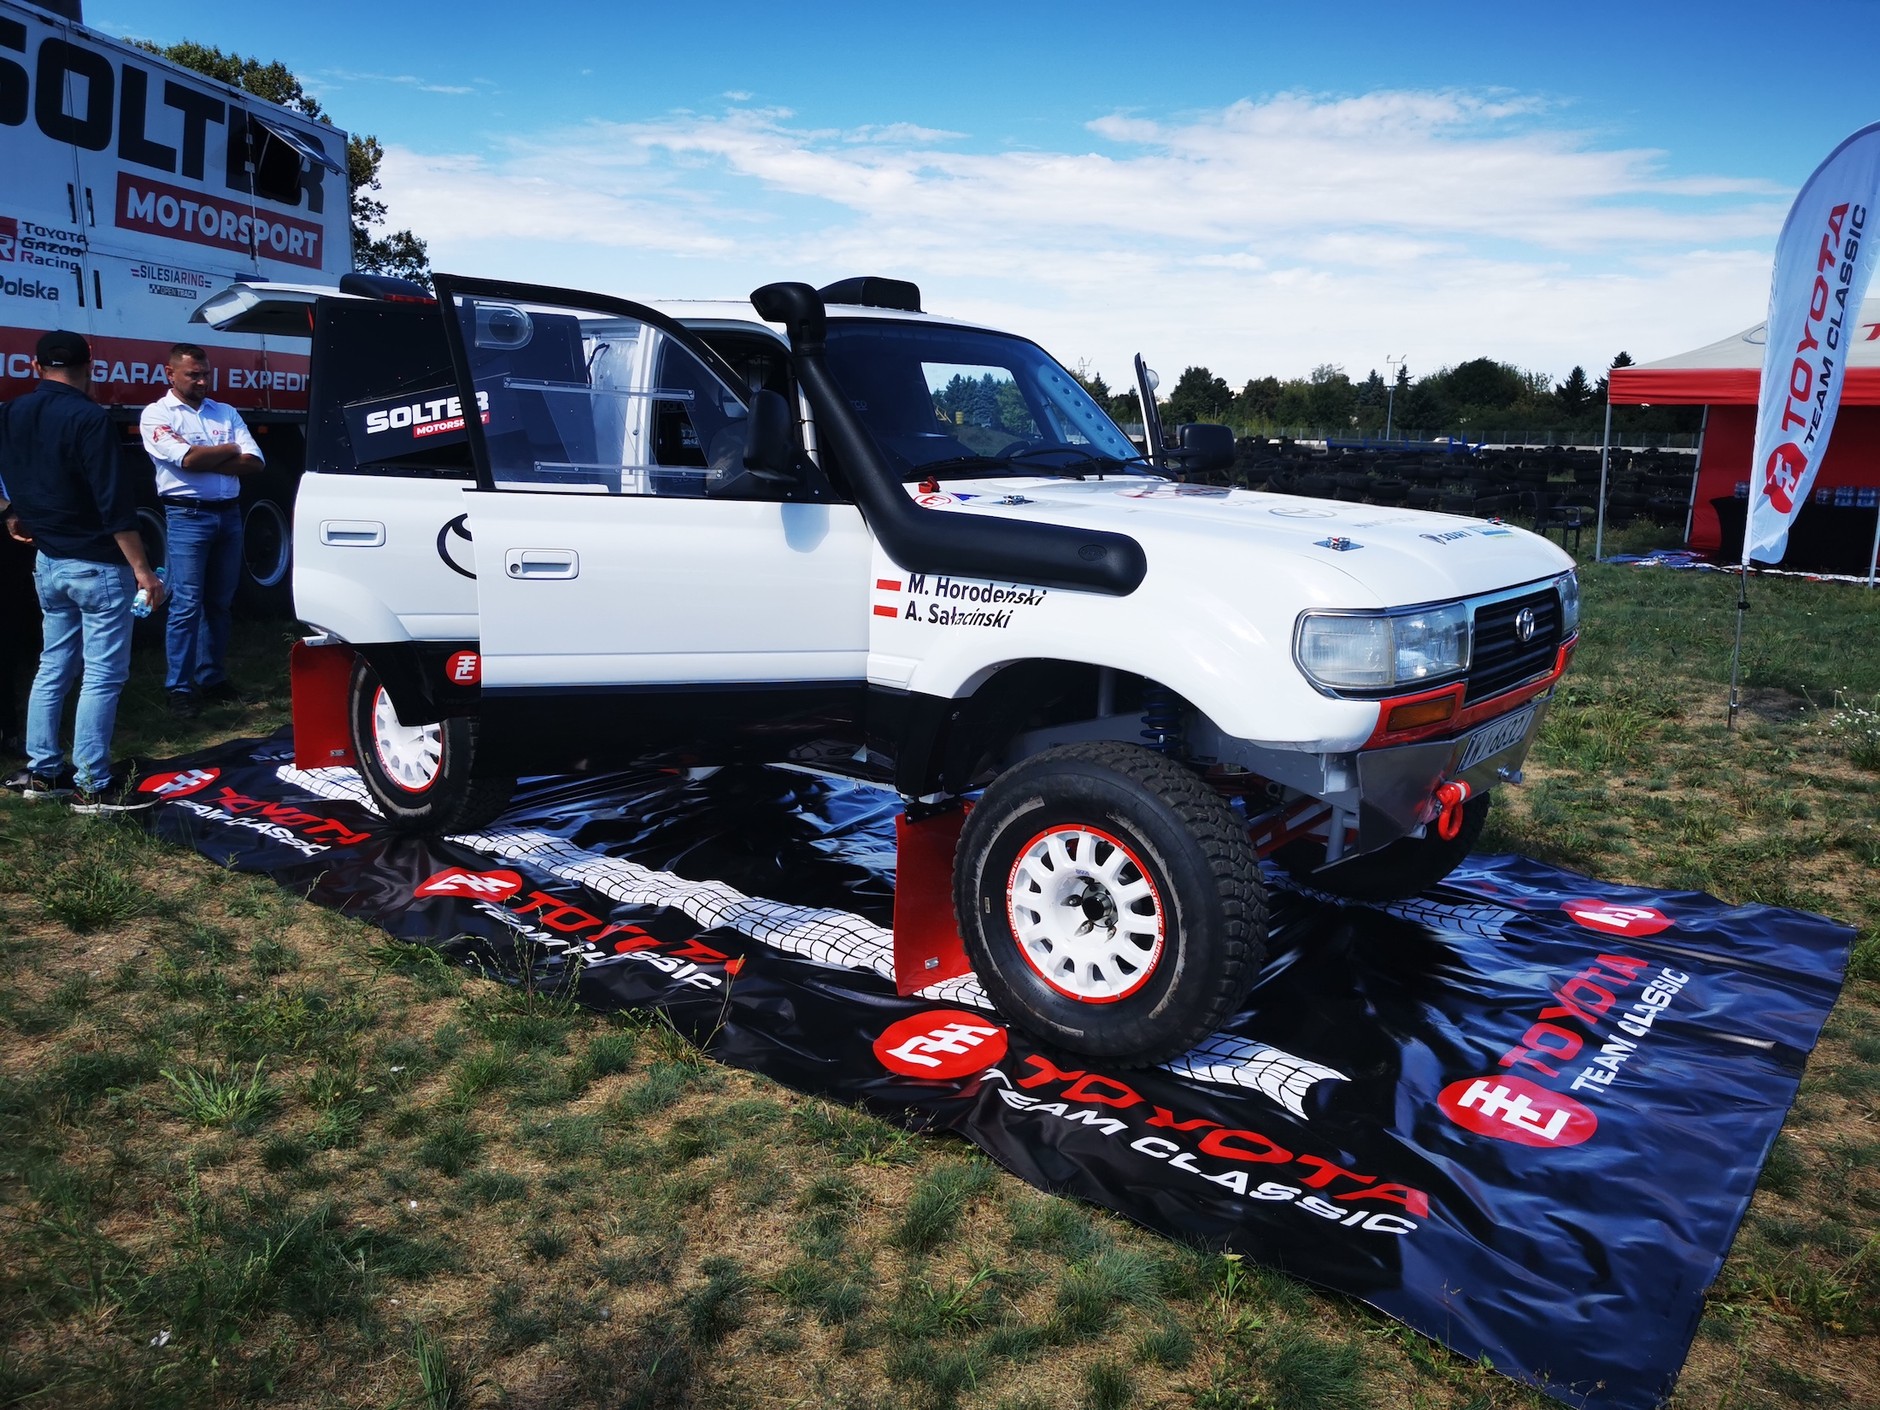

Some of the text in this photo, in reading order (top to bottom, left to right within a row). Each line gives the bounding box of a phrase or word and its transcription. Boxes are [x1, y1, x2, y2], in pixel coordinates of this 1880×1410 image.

[21, 221, 88, 245] TOYOTA
[21, 236, 83, 257] GAZOO
[126, 187, 320, 259] MOTORSPORT
[21, 250, 81, 275] Racing
[1782, 202, 1850, 432] TOYOTA
[1804, 203, 1867, 445] TEAM CLASSIC
[90, 359, 174, 386] GARA
[228, 368, 309, 391] EXPEDI
[905, 600, 922, 622] A.
[908, 573, 929, 595] M.
[1498, 953, 1649, 1078] TOYOTA
[1570, 967, 1690, 1093] TEAM CLASSIC
[979, 1068, 1419, 1236] TEAM CLASSIC
[1016, 1054, 1429, 1218] TOYOTA
